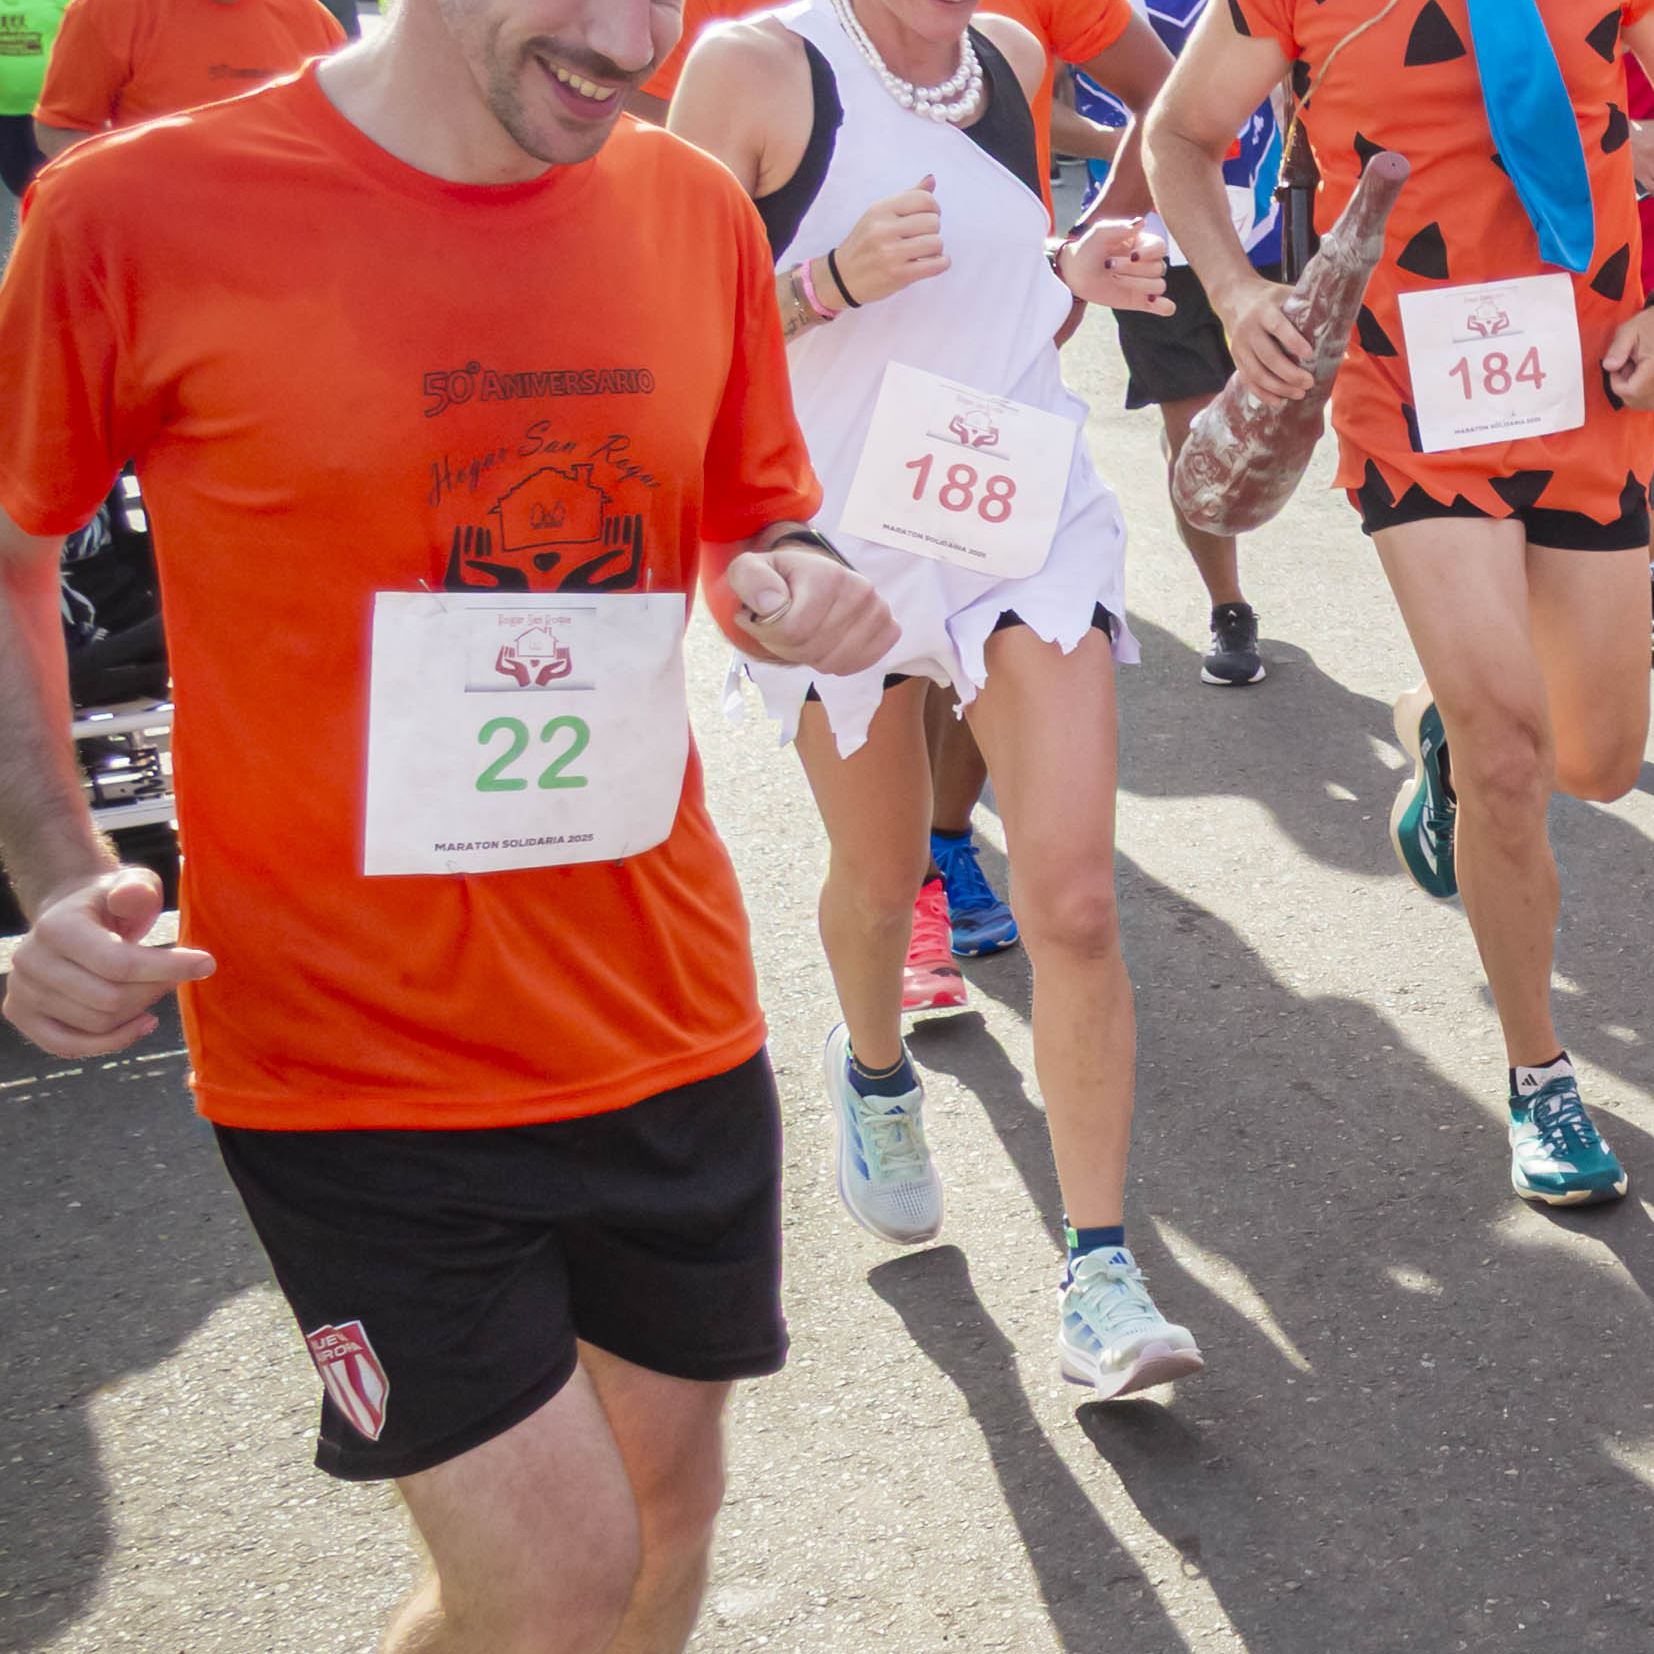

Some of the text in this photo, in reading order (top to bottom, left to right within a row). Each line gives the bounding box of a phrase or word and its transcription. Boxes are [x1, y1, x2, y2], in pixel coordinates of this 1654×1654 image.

[480, 368, 657, 402] ANIVERSARIO
[1448, 345, 1547, 400] 184
[517, 419, 577, 456] San
[904, 453, 1017, 524] 188
[882, 523, 924, 540] MARATON
[925, 534, 967, 553] SOLIDARIA
[475, 714, 591, 792] 22
[434, 833, 594, 852] MARATON SOLIDARIA 2025
